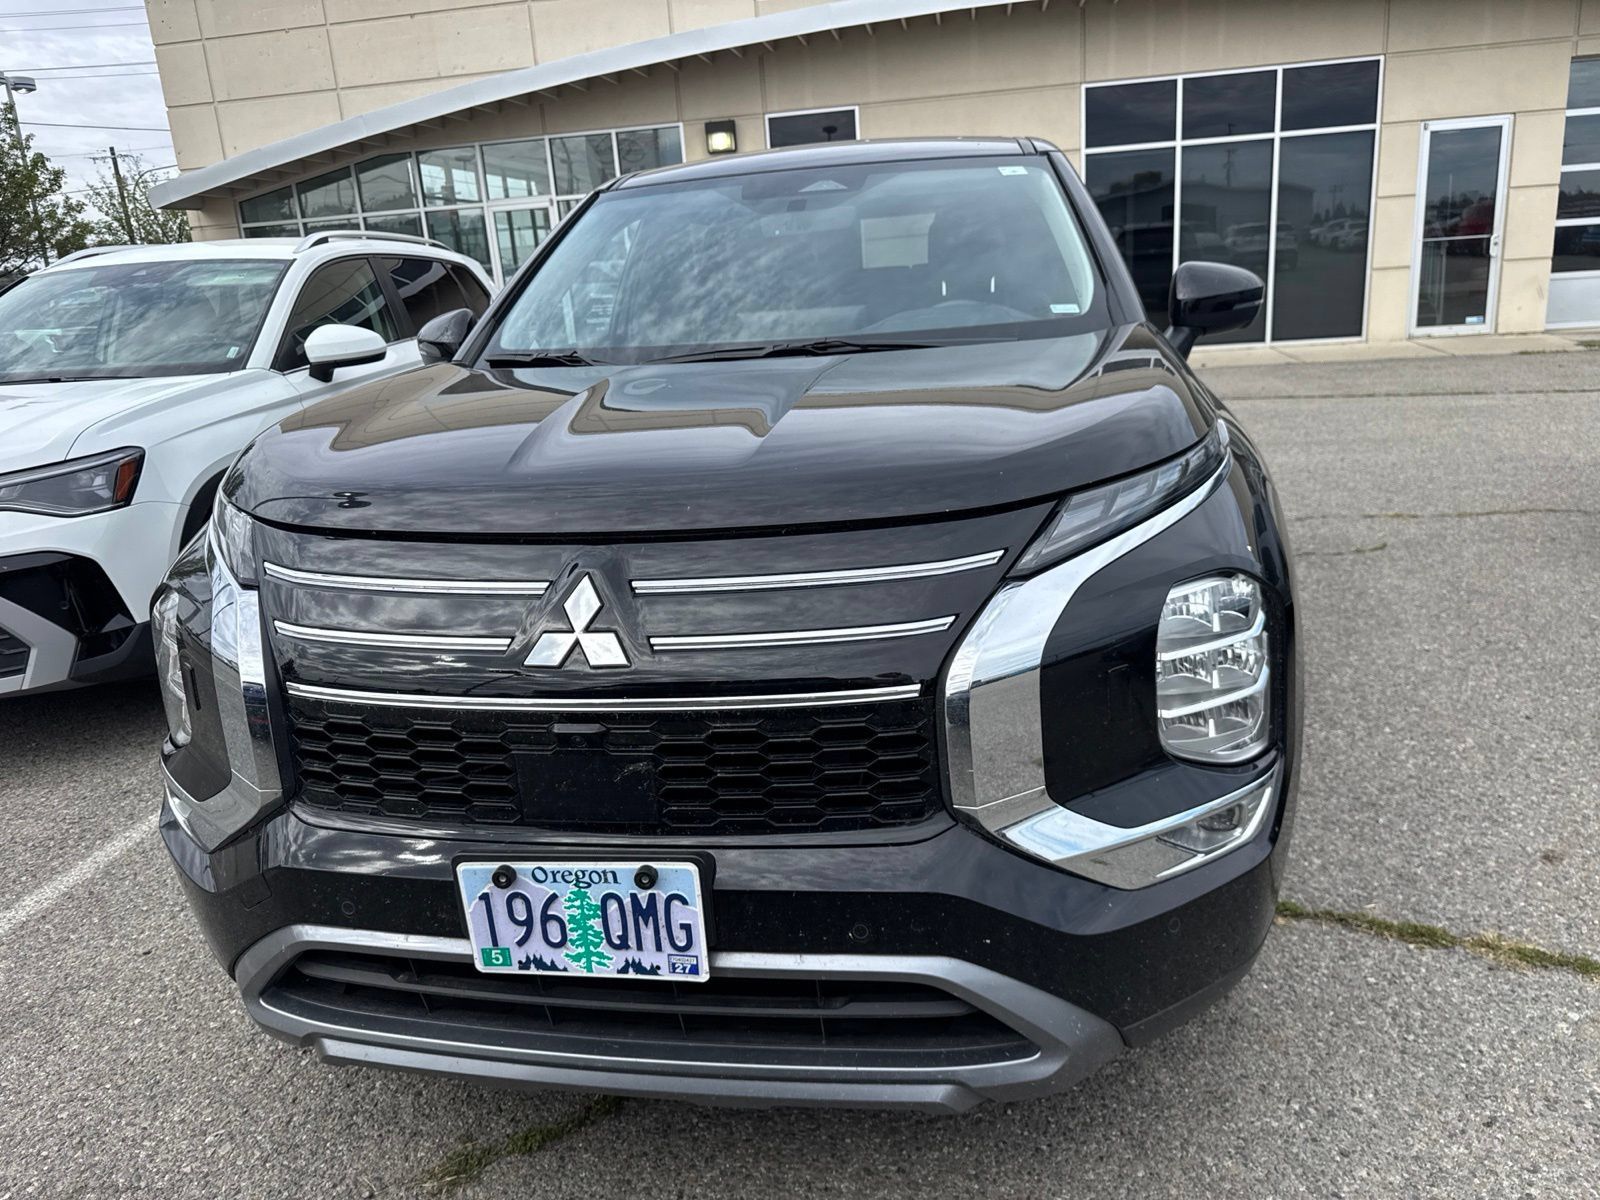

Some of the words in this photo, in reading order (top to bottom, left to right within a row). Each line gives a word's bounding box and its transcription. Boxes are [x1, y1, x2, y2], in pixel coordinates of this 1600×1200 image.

[531, 866, 621, 889] Oregon
[478, 891, 568, 949] 196
[600, 892, 693, 953] QMG
[491, 949, 503, 964] 5
[674, 963, 692, 974] 27
